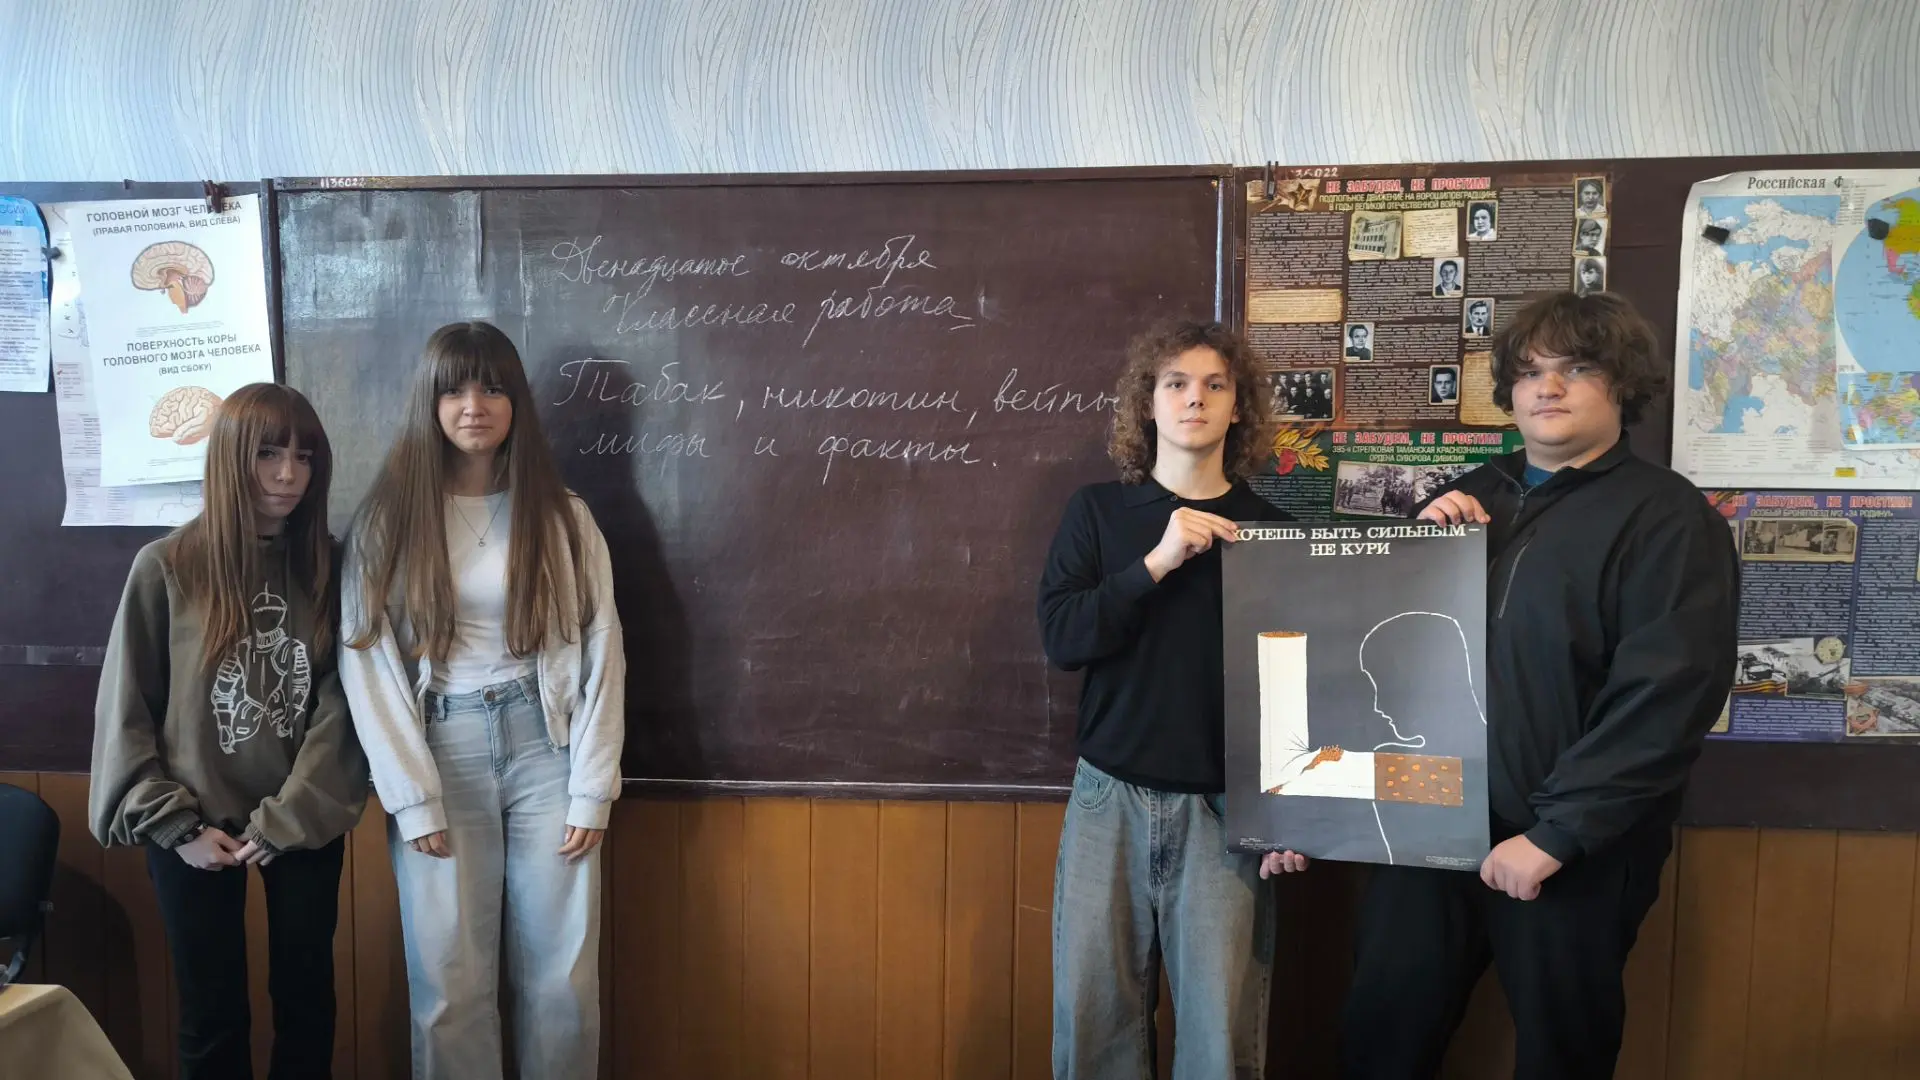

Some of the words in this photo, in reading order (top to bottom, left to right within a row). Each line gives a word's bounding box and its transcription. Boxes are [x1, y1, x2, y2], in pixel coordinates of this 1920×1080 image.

[1326, 180, 1340, 193] НЕ
[1347, 179, 1404, 194] ЗАБУДЕМ,
[1410, 178, 1426, 191] НЕ
[1431, 177, 1491, 191] ПРОСТИМ!
[1747, 176, 1826, 189] Российская
[1328, 203, 1333, 211] В
[1335, 202, 1353, 211] ГОДЫ
[1355, 201, 1385, 211] ВЕЛИКОЙ
[1387, 200, 1438, 210] ОТЕЧЕСТВЕННОЙ
[1440, 199, 1465, 208] ВОЙНЫ
[1366, 193, 1403, 202] ДВИЖЕНИЕ
[1404, 192, 1414, 200] НА
[87, 208, 149, 222] ГОЛОВНОЙ
[152, 206, 182, 217] МОЗГ
[184, 201, 242, 214] ЧЕЛЕКА
[93, 225, 132, 237] (ПРАВАЯ
[189, 219, 208, 228] ВИД
[209, 217, 241, 226] СЛЕВА)
[552, 235, 750, 297] Двенадцатое
[781, 235, 938, 288] октября
[603, 292, 796, 334] Классная
[802, 287, 972, 348] работа
[127, 336, 204, 352] ПОВЕРХНОСТЬ
[207, 334, 237, 345] КОРЫ
[103, 352, 168, 367] ГОЛОВНОГО
[170, 349, 205, 361] МОЗГА
[207, 343, 261, 357] ЧЕЛОВЕКА
[159, 365, 179, 376] (ВИД
[180, 362, 212, 373] СБОКУ)
[763, 385, 978, 429] никотин,
[1332, 431, 1348, 444] НЕ
[1354, 431, 1413, 446] ЗАБУДЕМ,
[1420, 432, 1435, 444] НЕ
[1442, 432, 1503, 445] ПРОСТИМ!
[1352, 445, 1394, 453] СТРЕЛКОВАЯ
[1395, 445, 1435, 454] ТАМАНСКАЯ
[580, 430, 711, 476] мифы
[755, 435, 779, 458] и
[818, 430, 999, 487] факты.
[1369, 454, 1395, 462] ОРДЕНА
[1396, 454, 1431, 462] СУВОРОВА
[1432, 454, 1465, 463] ДИВИЗИЯ
[1827, 495, 1842, 507] НЕ
[1310, 527, 1361, 540] БЫТЬ
[1366, 524, 1466, 539] СИЛЬНЫМ
[1310, 543, 1336, 556] НЕ
[1340, 542, 1391, 556] КУРИ
